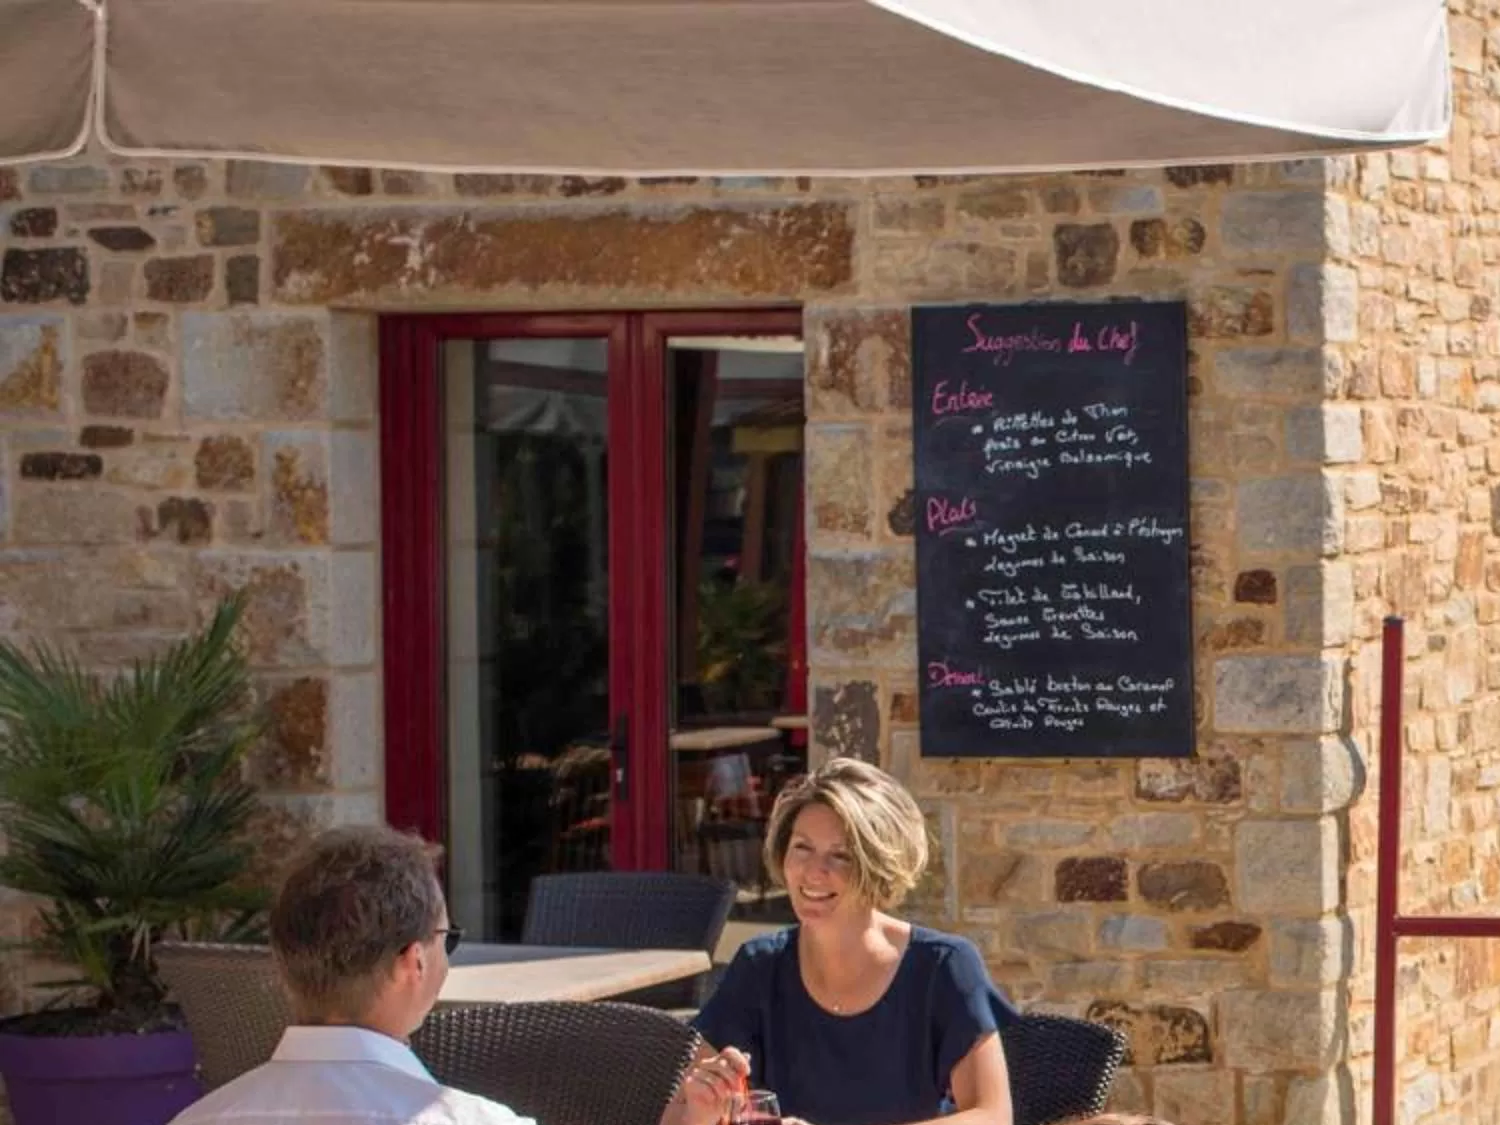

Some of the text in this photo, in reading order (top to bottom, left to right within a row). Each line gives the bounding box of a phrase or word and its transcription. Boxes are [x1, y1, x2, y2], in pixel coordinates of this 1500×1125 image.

[1067, 321, 1092, 354] du
[1097, 320, 1138, 366] Chef
[1061, 411, 1078, 425] de
[1082, 403, 1129, 421] Thon
[1043, 525, 1058, 540] de
[1051, 550, 1065, 564] de
[1032, 586, 1049, 602] de
[1051, 624, 1072, 640] de
[1022, 699, 1038, 713] de
